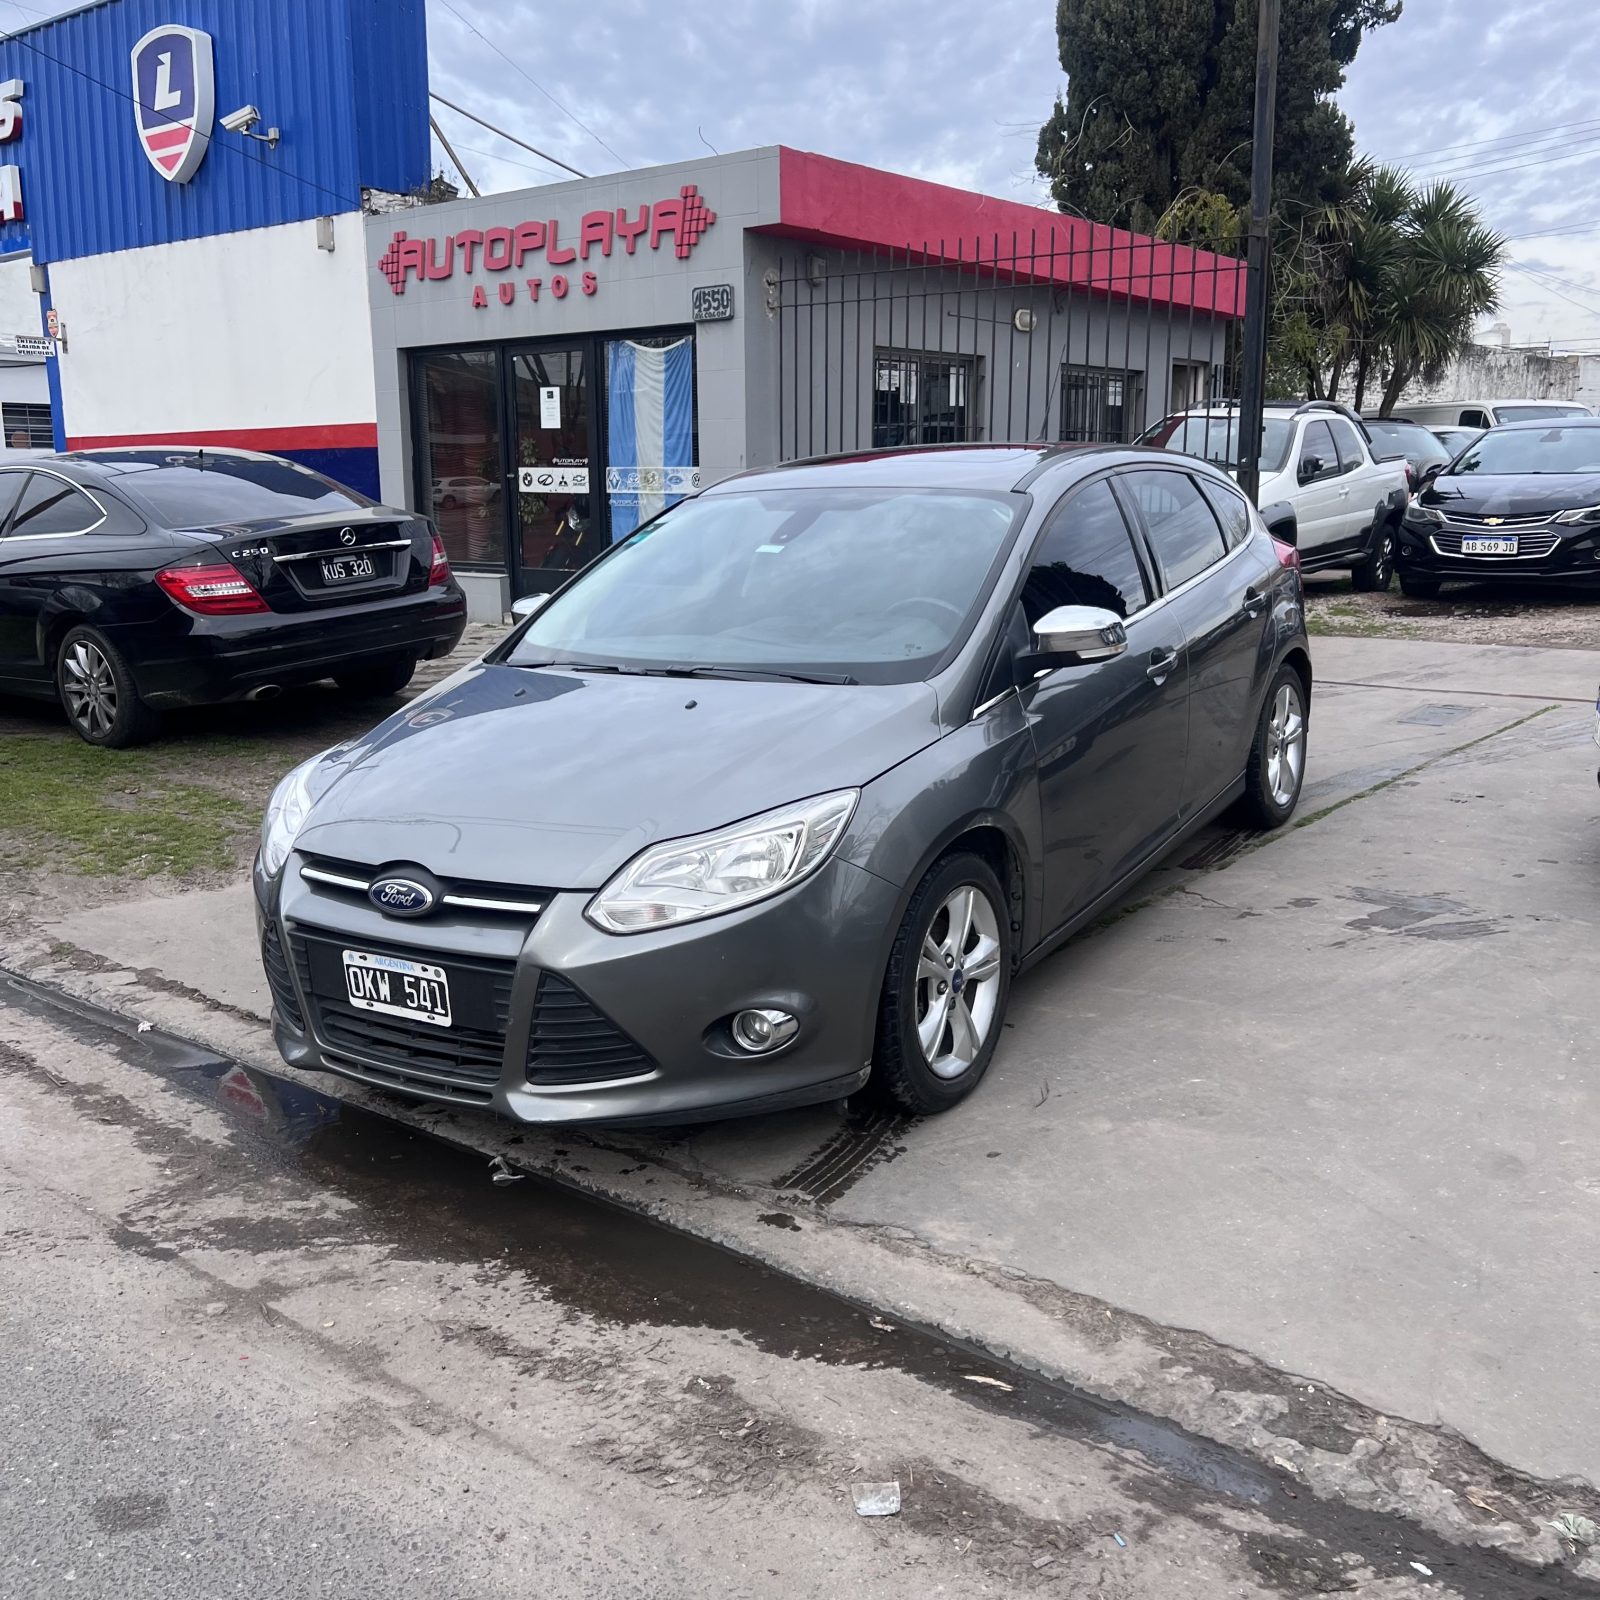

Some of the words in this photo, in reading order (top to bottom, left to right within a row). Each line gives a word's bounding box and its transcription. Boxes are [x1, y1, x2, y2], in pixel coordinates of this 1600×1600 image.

[396, 197, 688, 281] AUTOPLAYA
[472, 271, 598, 308] AUTOS
[694, 288, 730, 312] 4550
[242, 547, 269, 557] 250
[1465, 541, 1477, 551] AB
[1480, 541, 1499, 552] 569
[1502, 542, 1515, 552] JD
[322, 563, 346, 580] KUS
[350, 559, 373, 576] 320
[380, 883, 416, 906] Ford
[374, 957, 416, 972] ARGENTINA
[348, 966, 391, 1002] OKW
[403, 975, 446, 1014] 541
